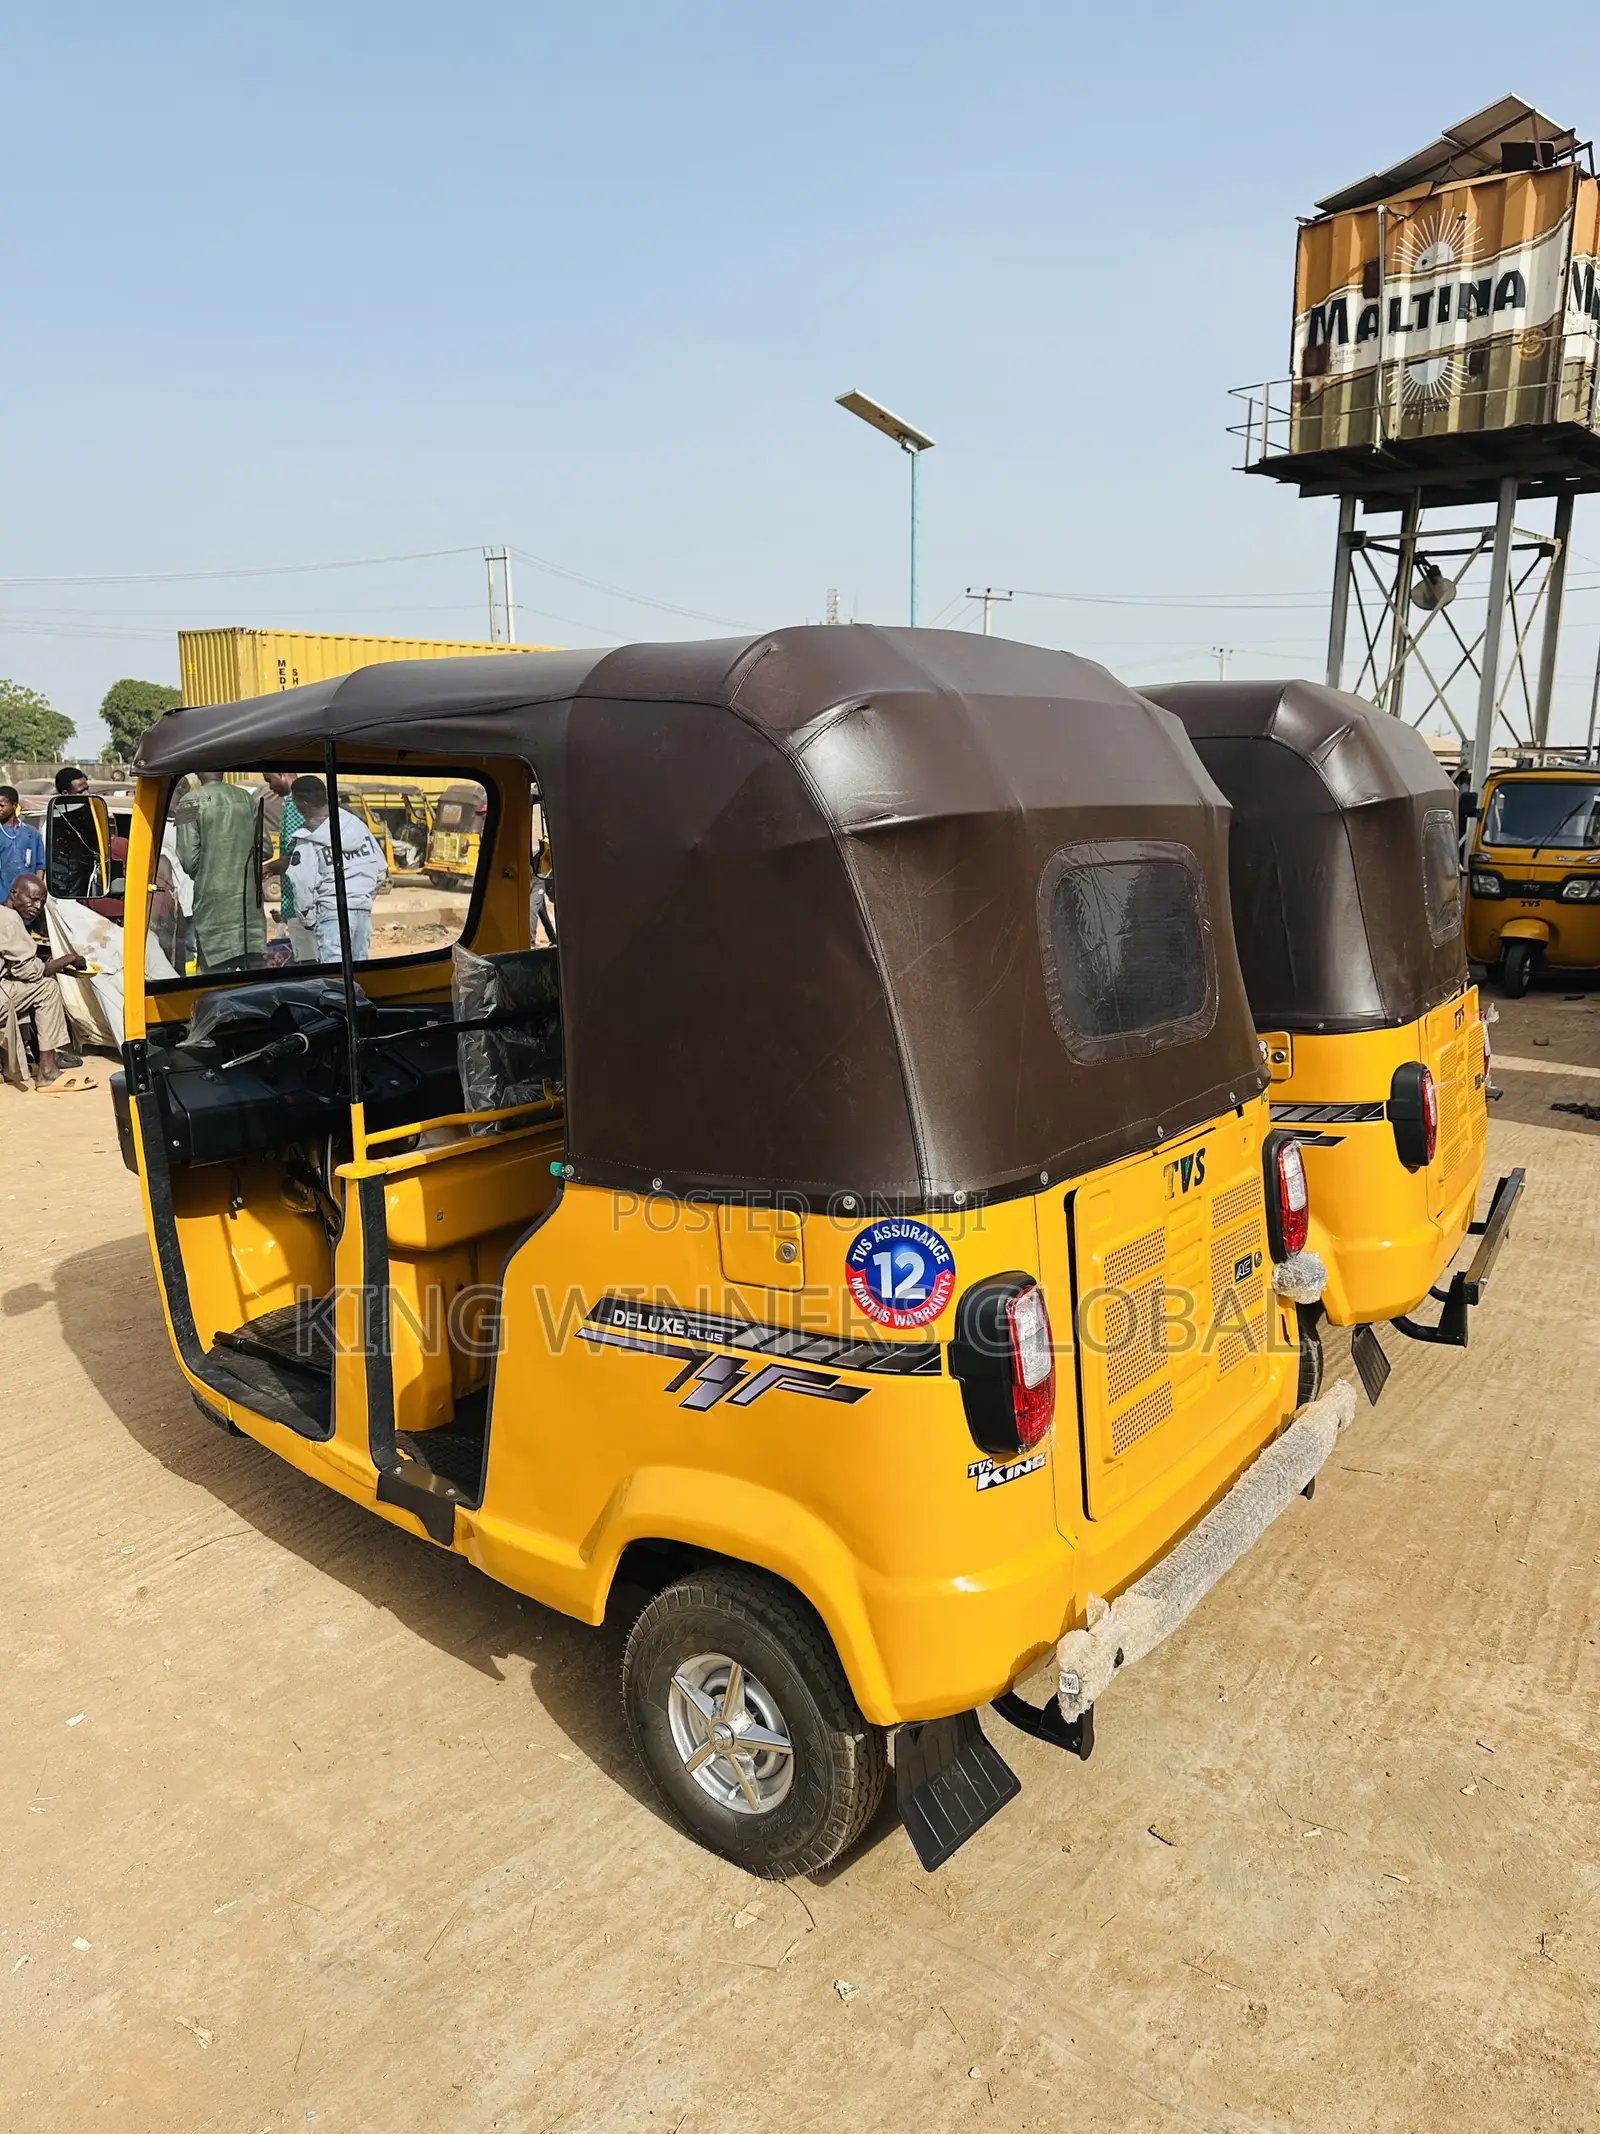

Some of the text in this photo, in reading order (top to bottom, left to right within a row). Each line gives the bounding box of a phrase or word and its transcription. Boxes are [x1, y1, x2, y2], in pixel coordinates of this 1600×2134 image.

[1309, 270, 1526, 347] MALTINA
[1520, 900, 1541, 908] TVS
[1163, 1148, 1206, 1201] TVS
[852, 1224, 950, 1265] TVS ASSURANCE
[872, 1251, 926, 1300] 12
[851, 1276, 891, 1323] MONTHS
[612, 1309, 723, 1343] DELUXE PLUS
[968, 1458, 993, 1477] TVS
[977, 1454, 1046, 1490] KING
